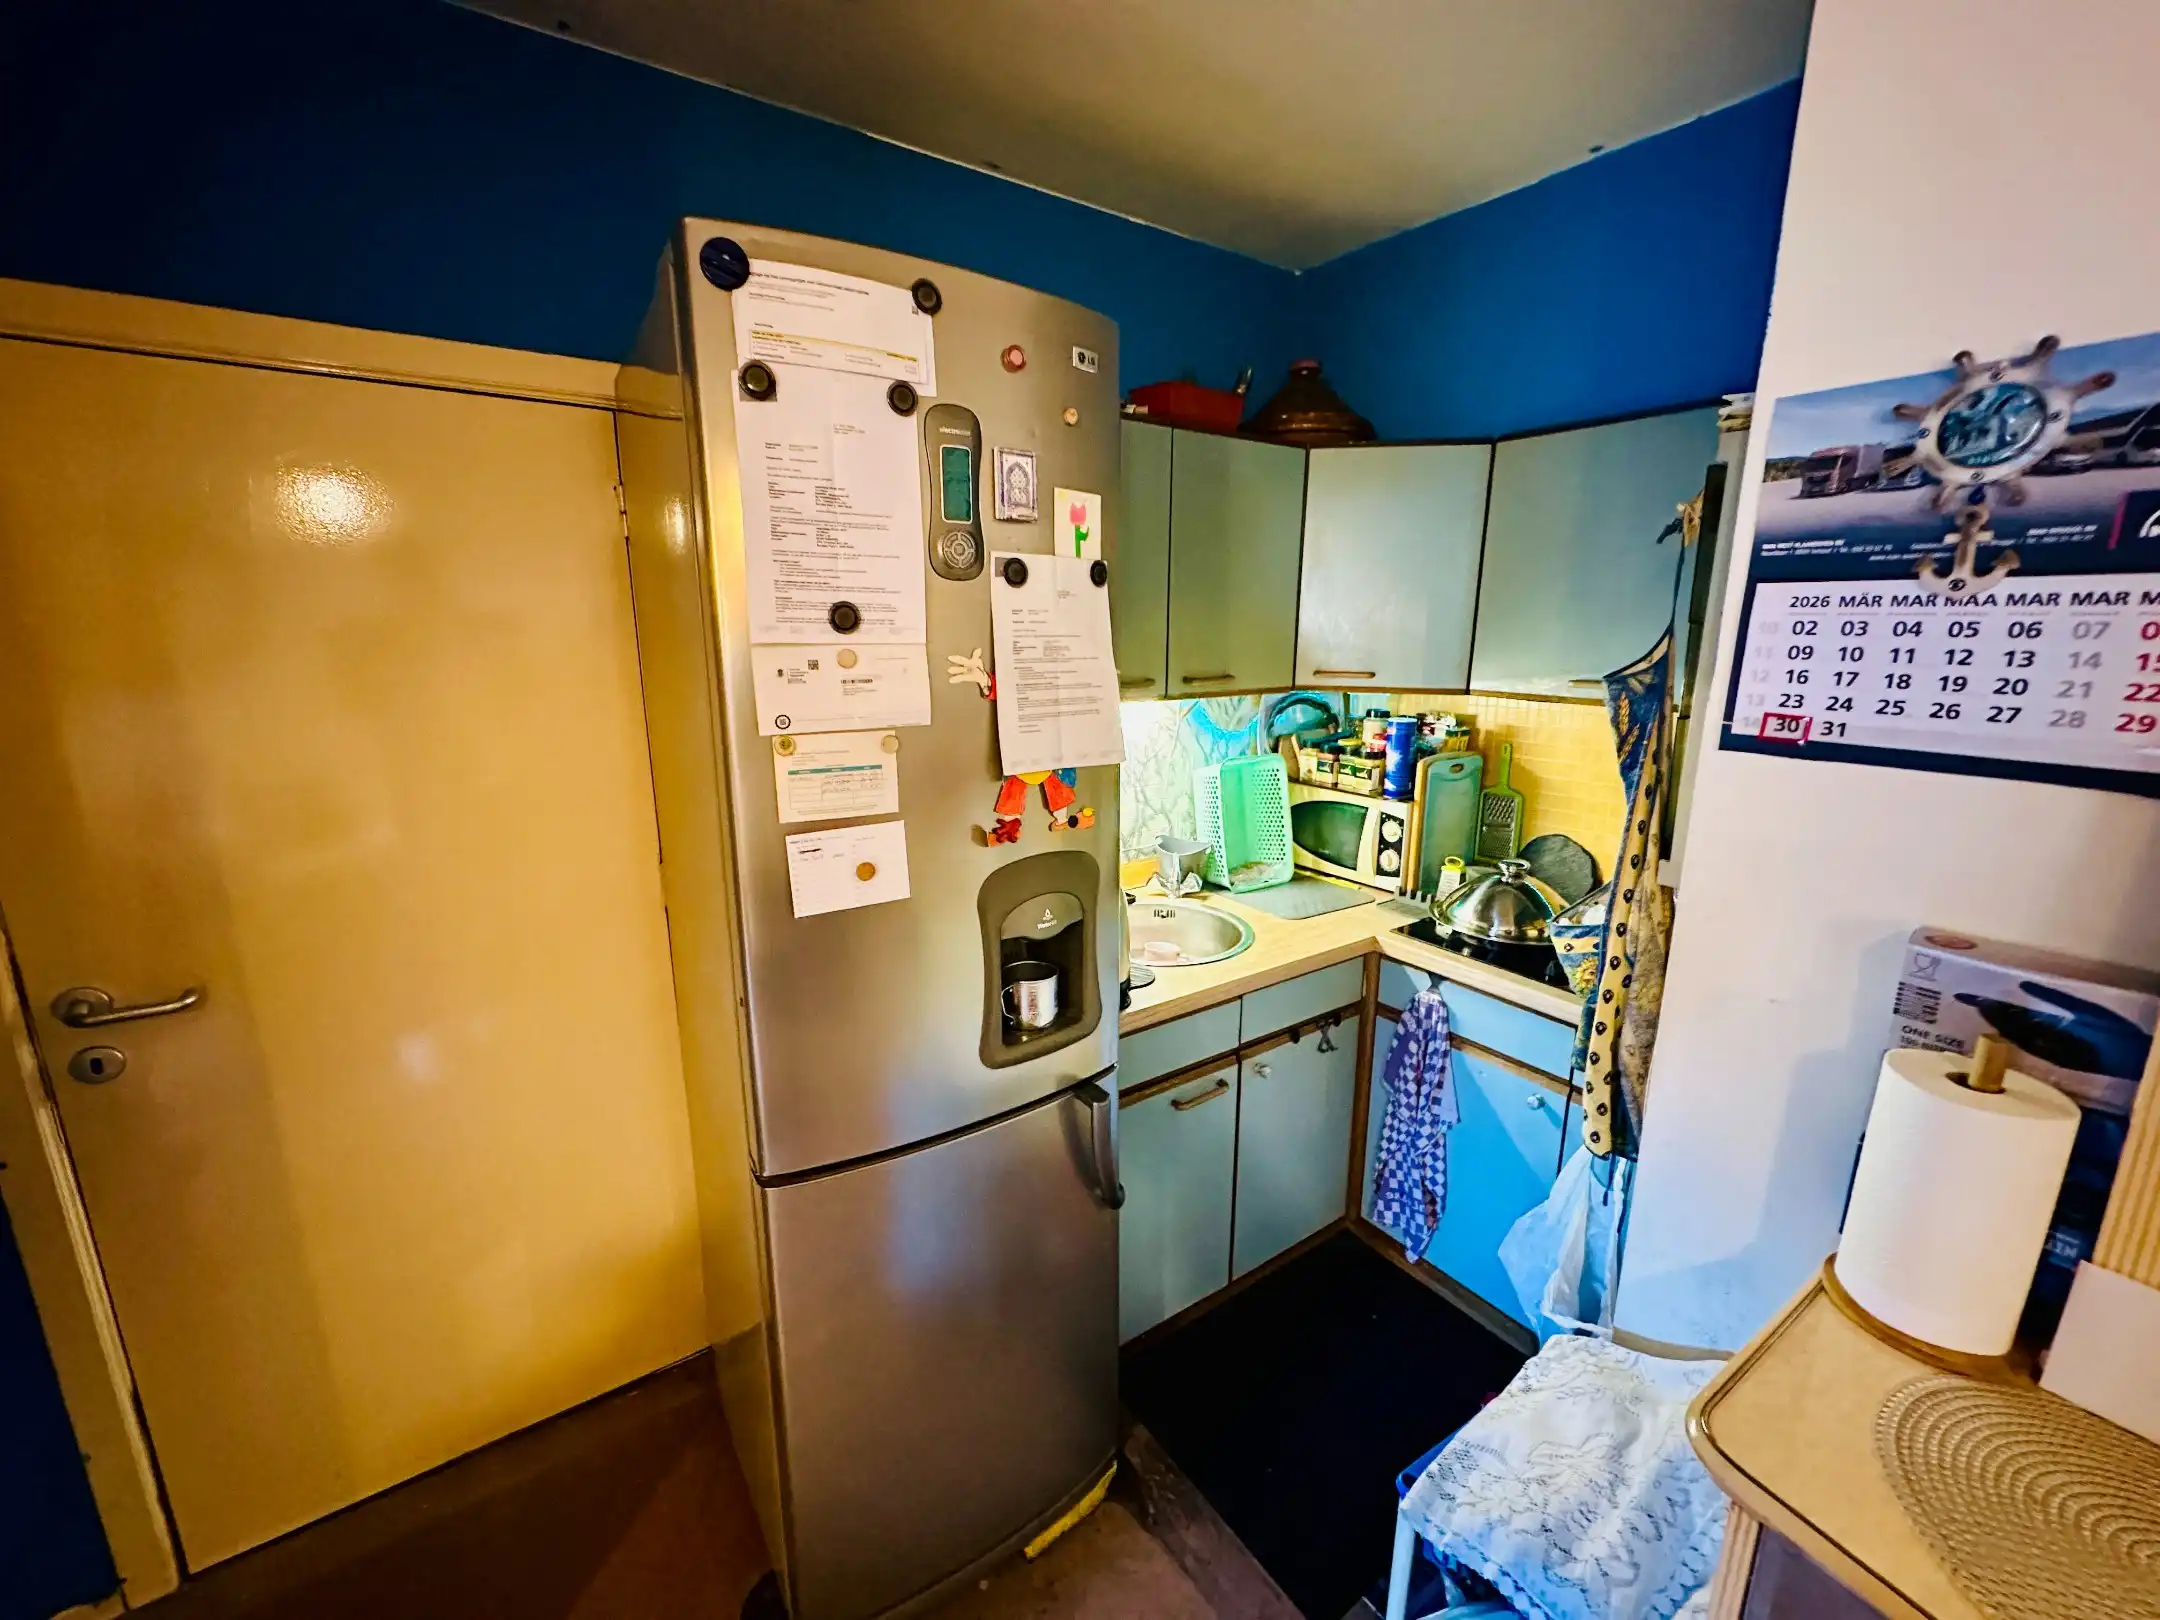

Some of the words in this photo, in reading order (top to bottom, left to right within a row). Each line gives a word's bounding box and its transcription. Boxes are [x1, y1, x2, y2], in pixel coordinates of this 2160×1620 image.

[1788, 595, 1831, 608] 2026
[1838, 592, 1883, 608] MÄR
[1890, 593, 1938, 608] MAR
[1943, 593, 1998, 608] MAA
[2004, 592, 2062, 608] MAR
[2069, 591, 2131, 607] MAR
[1791, 620, 1819, 636] 02
[1840, 620, 1869, 637] 03
[1892, 620, 1924, 637] 04
[1947, 621, 1981, 639] 05
[2006, 621, 2044, 639] 06
[2071, 621, 2111, 640] 07
[2140, 621, 2160, 640] 0
[1787, 645, 1814, 661] 09
[1837, 646, 1865, 662] 10
[1889, 647, 1917, 664] 11
[1944, 648, 1974, 666] 12
[2003, 650, 2037, 668] 13
[2067, 651, 2103, 670] 14
[1784, 669, 1810, 685] 16
[1832, 671, 1860, 687] 17
[1884, 673, 1912, 690] 18
[1938, 675, 1968, 693] 19
[1992, 677, 2029, 696] 20
[2055, 680, 2094, 699] 21
[2122, 683, 2160, 703] 22
[1778, 693, 1805, 709] 23
[1825, 696, 1854, 712] 24
[1874, 699, 1907, 716] 25
[1929, 702, 1961, 720] 26
[1986, 705, 2023, 724] 27
[2047, 709, 2087, 728] 28
[2114, 713, 2158, 733] 29
[1773, 717, 1801, 733] 30
[1820, 720, 1847, 737] 31
[1902, 1025, 1930, 1038] ONE
[1935, 1034, 1965, 1049] SIZE
